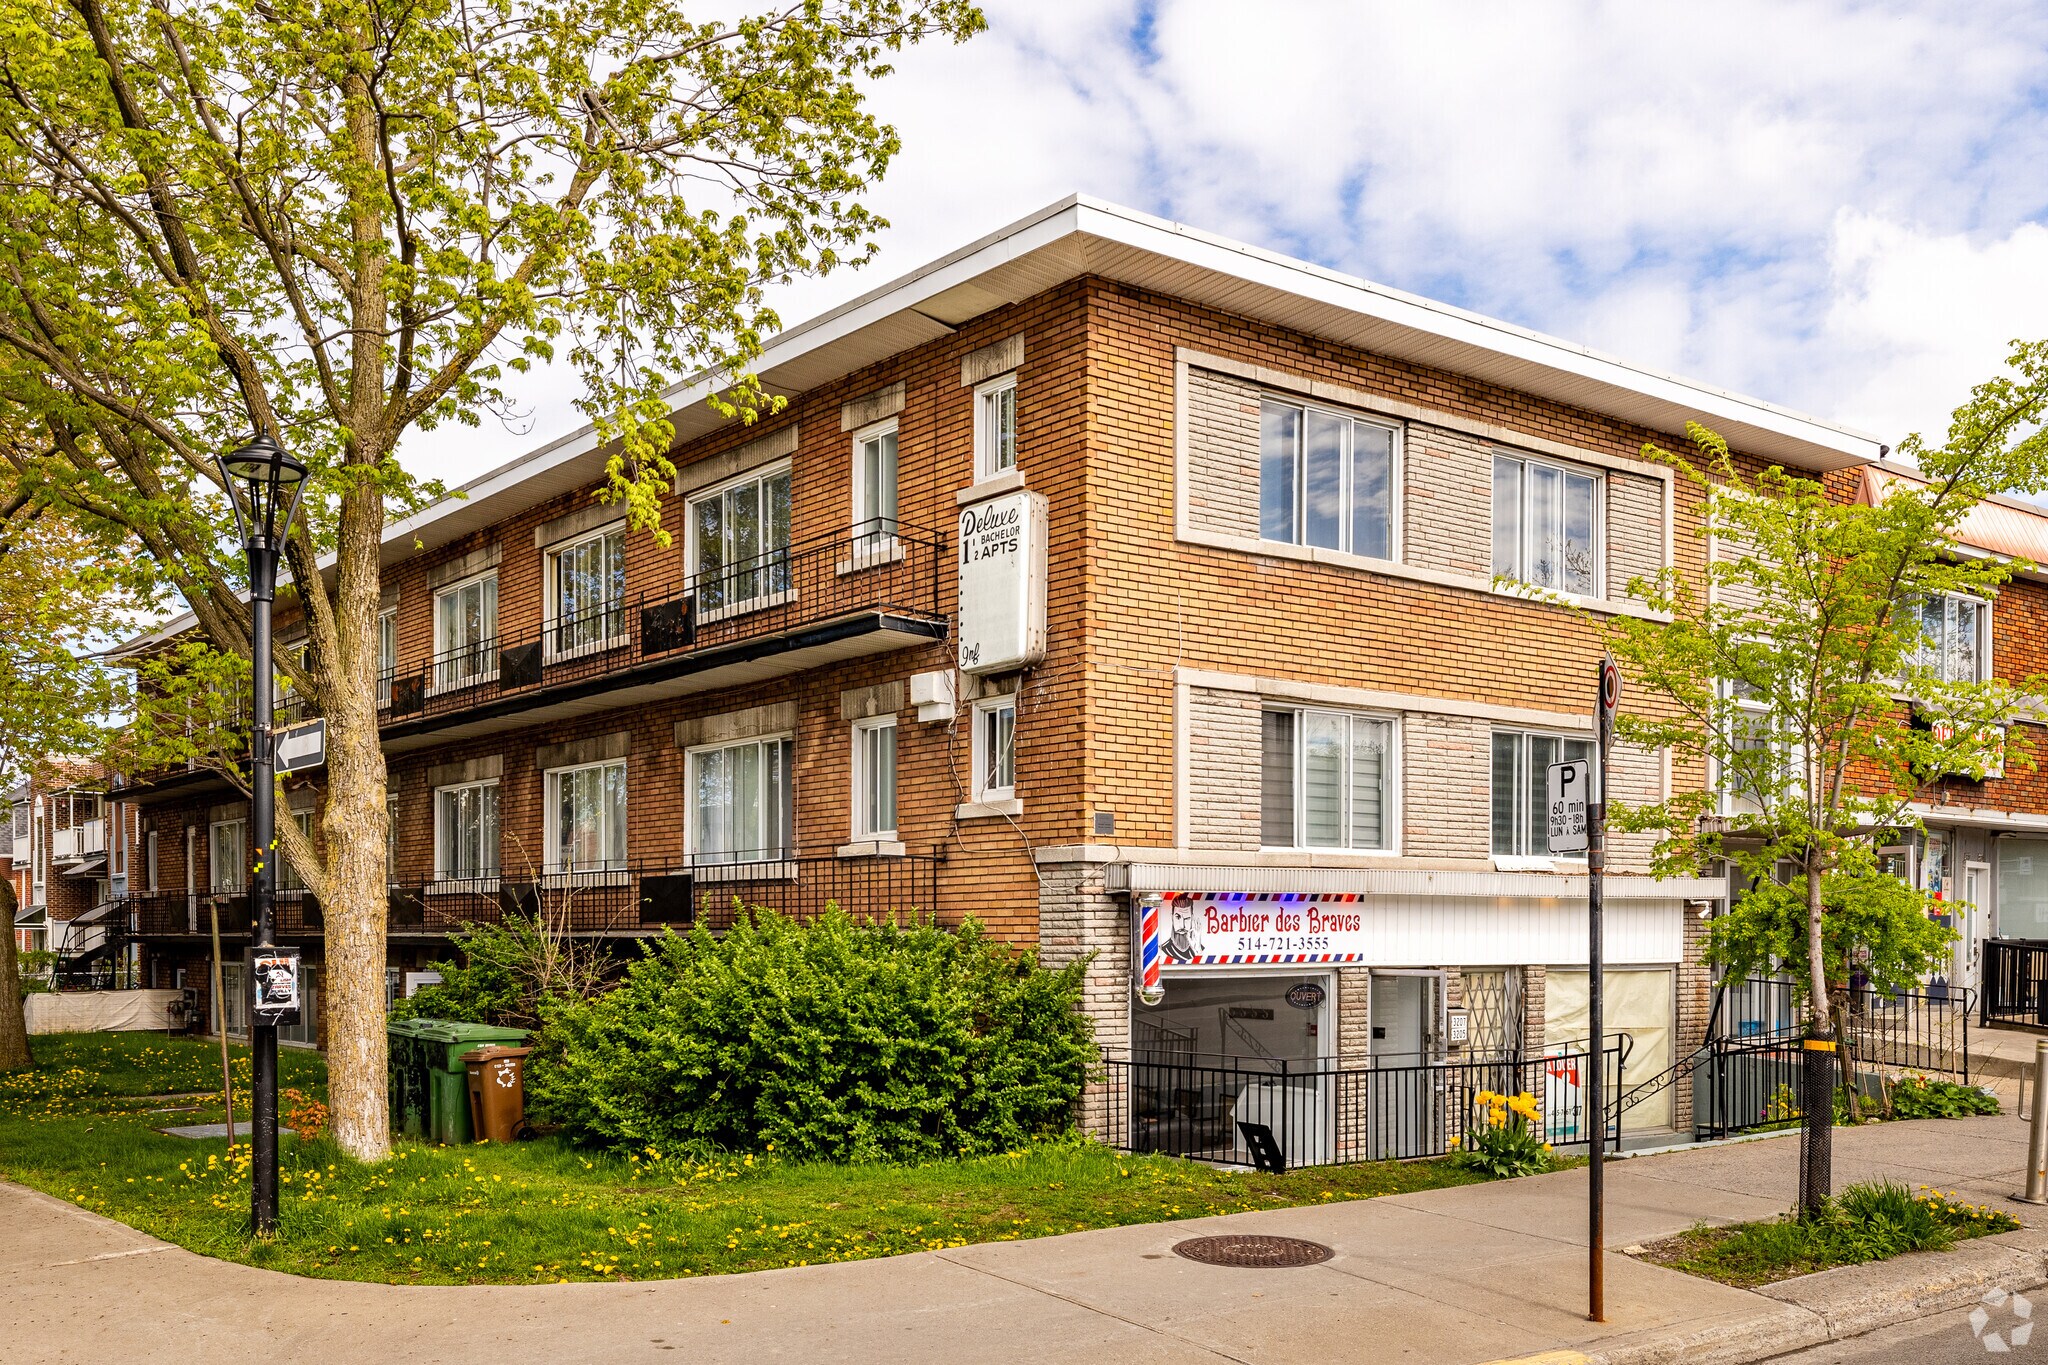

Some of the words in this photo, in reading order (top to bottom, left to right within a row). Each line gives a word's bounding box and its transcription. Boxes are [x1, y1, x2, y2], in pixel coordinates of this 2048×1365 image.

[961, 504, 1019, 537] Deluxe
[981, 525, 1020, 545] BACHELOR
[981, 538, 1018, 560] APTS
[1561, 765, 1576, 798] P
[1552, 801, 1564, 815] 60
[1568, 799, 1584, 814] min
[1550, 825, 1563, 838] LUN
[1572, 824, 1587, 835] SAM
[1204, 905, 1269, 935] Barbier
[1275, 906, 1300, 933] des
[1306, 906, 1361, 934] Braves
[1237, 937, 1329, 951] 514-721-3555
[1290, 990, 1322, 1002] OUVERT
[1453, 1017, 1466, 1027] 3207
[1453, 1029, 1466, 1039] 3205
